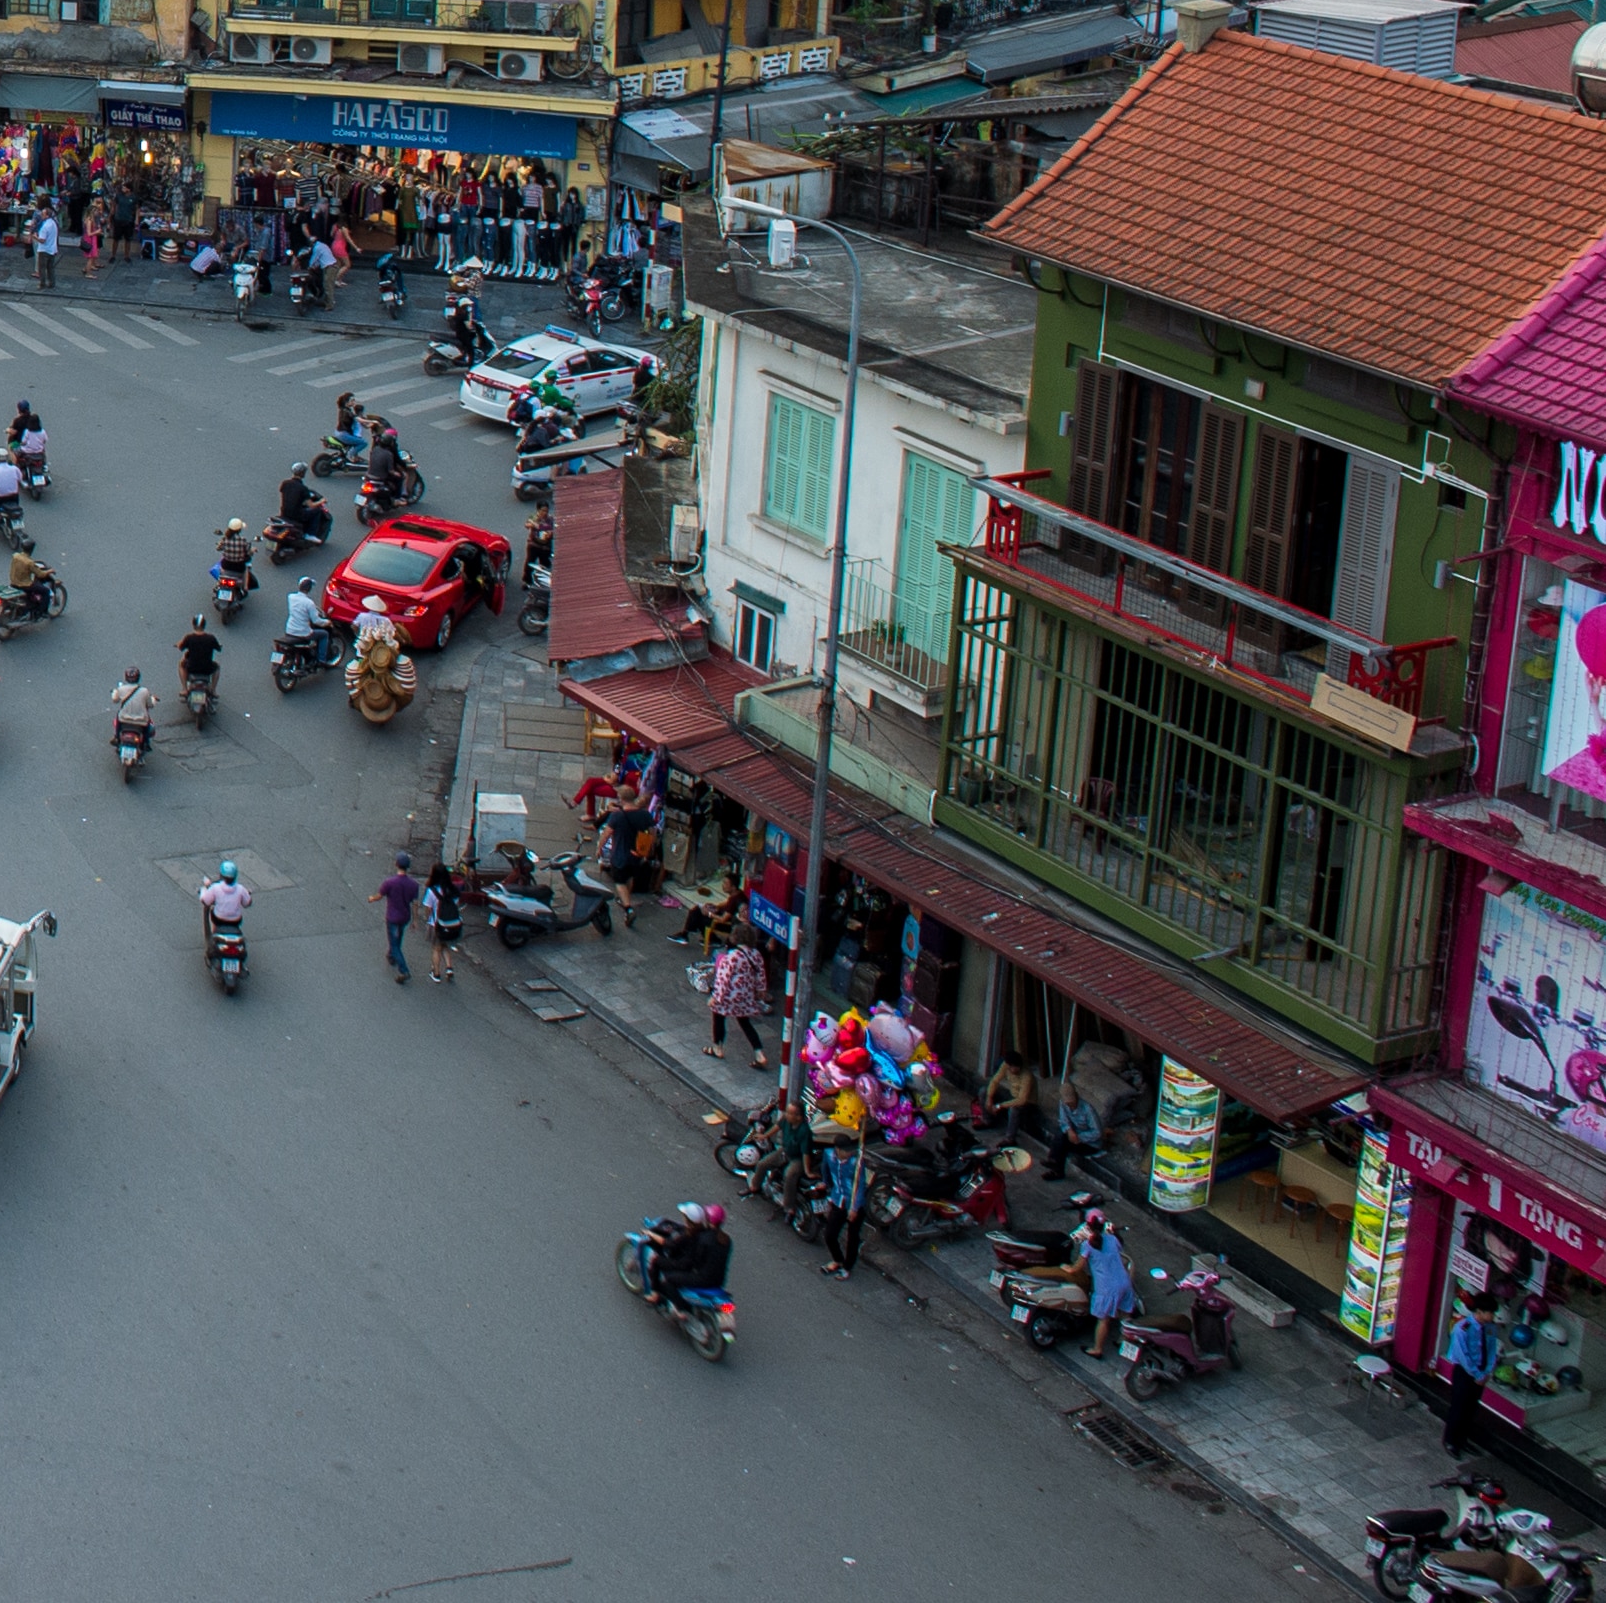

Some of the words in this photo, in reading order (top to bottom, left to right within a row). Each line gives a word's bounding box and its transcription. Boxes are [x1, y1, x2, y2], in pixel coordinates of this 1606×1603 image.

[155, 114, 182, 127] THAO
[331, 101, 449, 133] HAFASCO
[331, 128, 357, 138] CÔNG
[389, 133, 418, 142] TRANG
